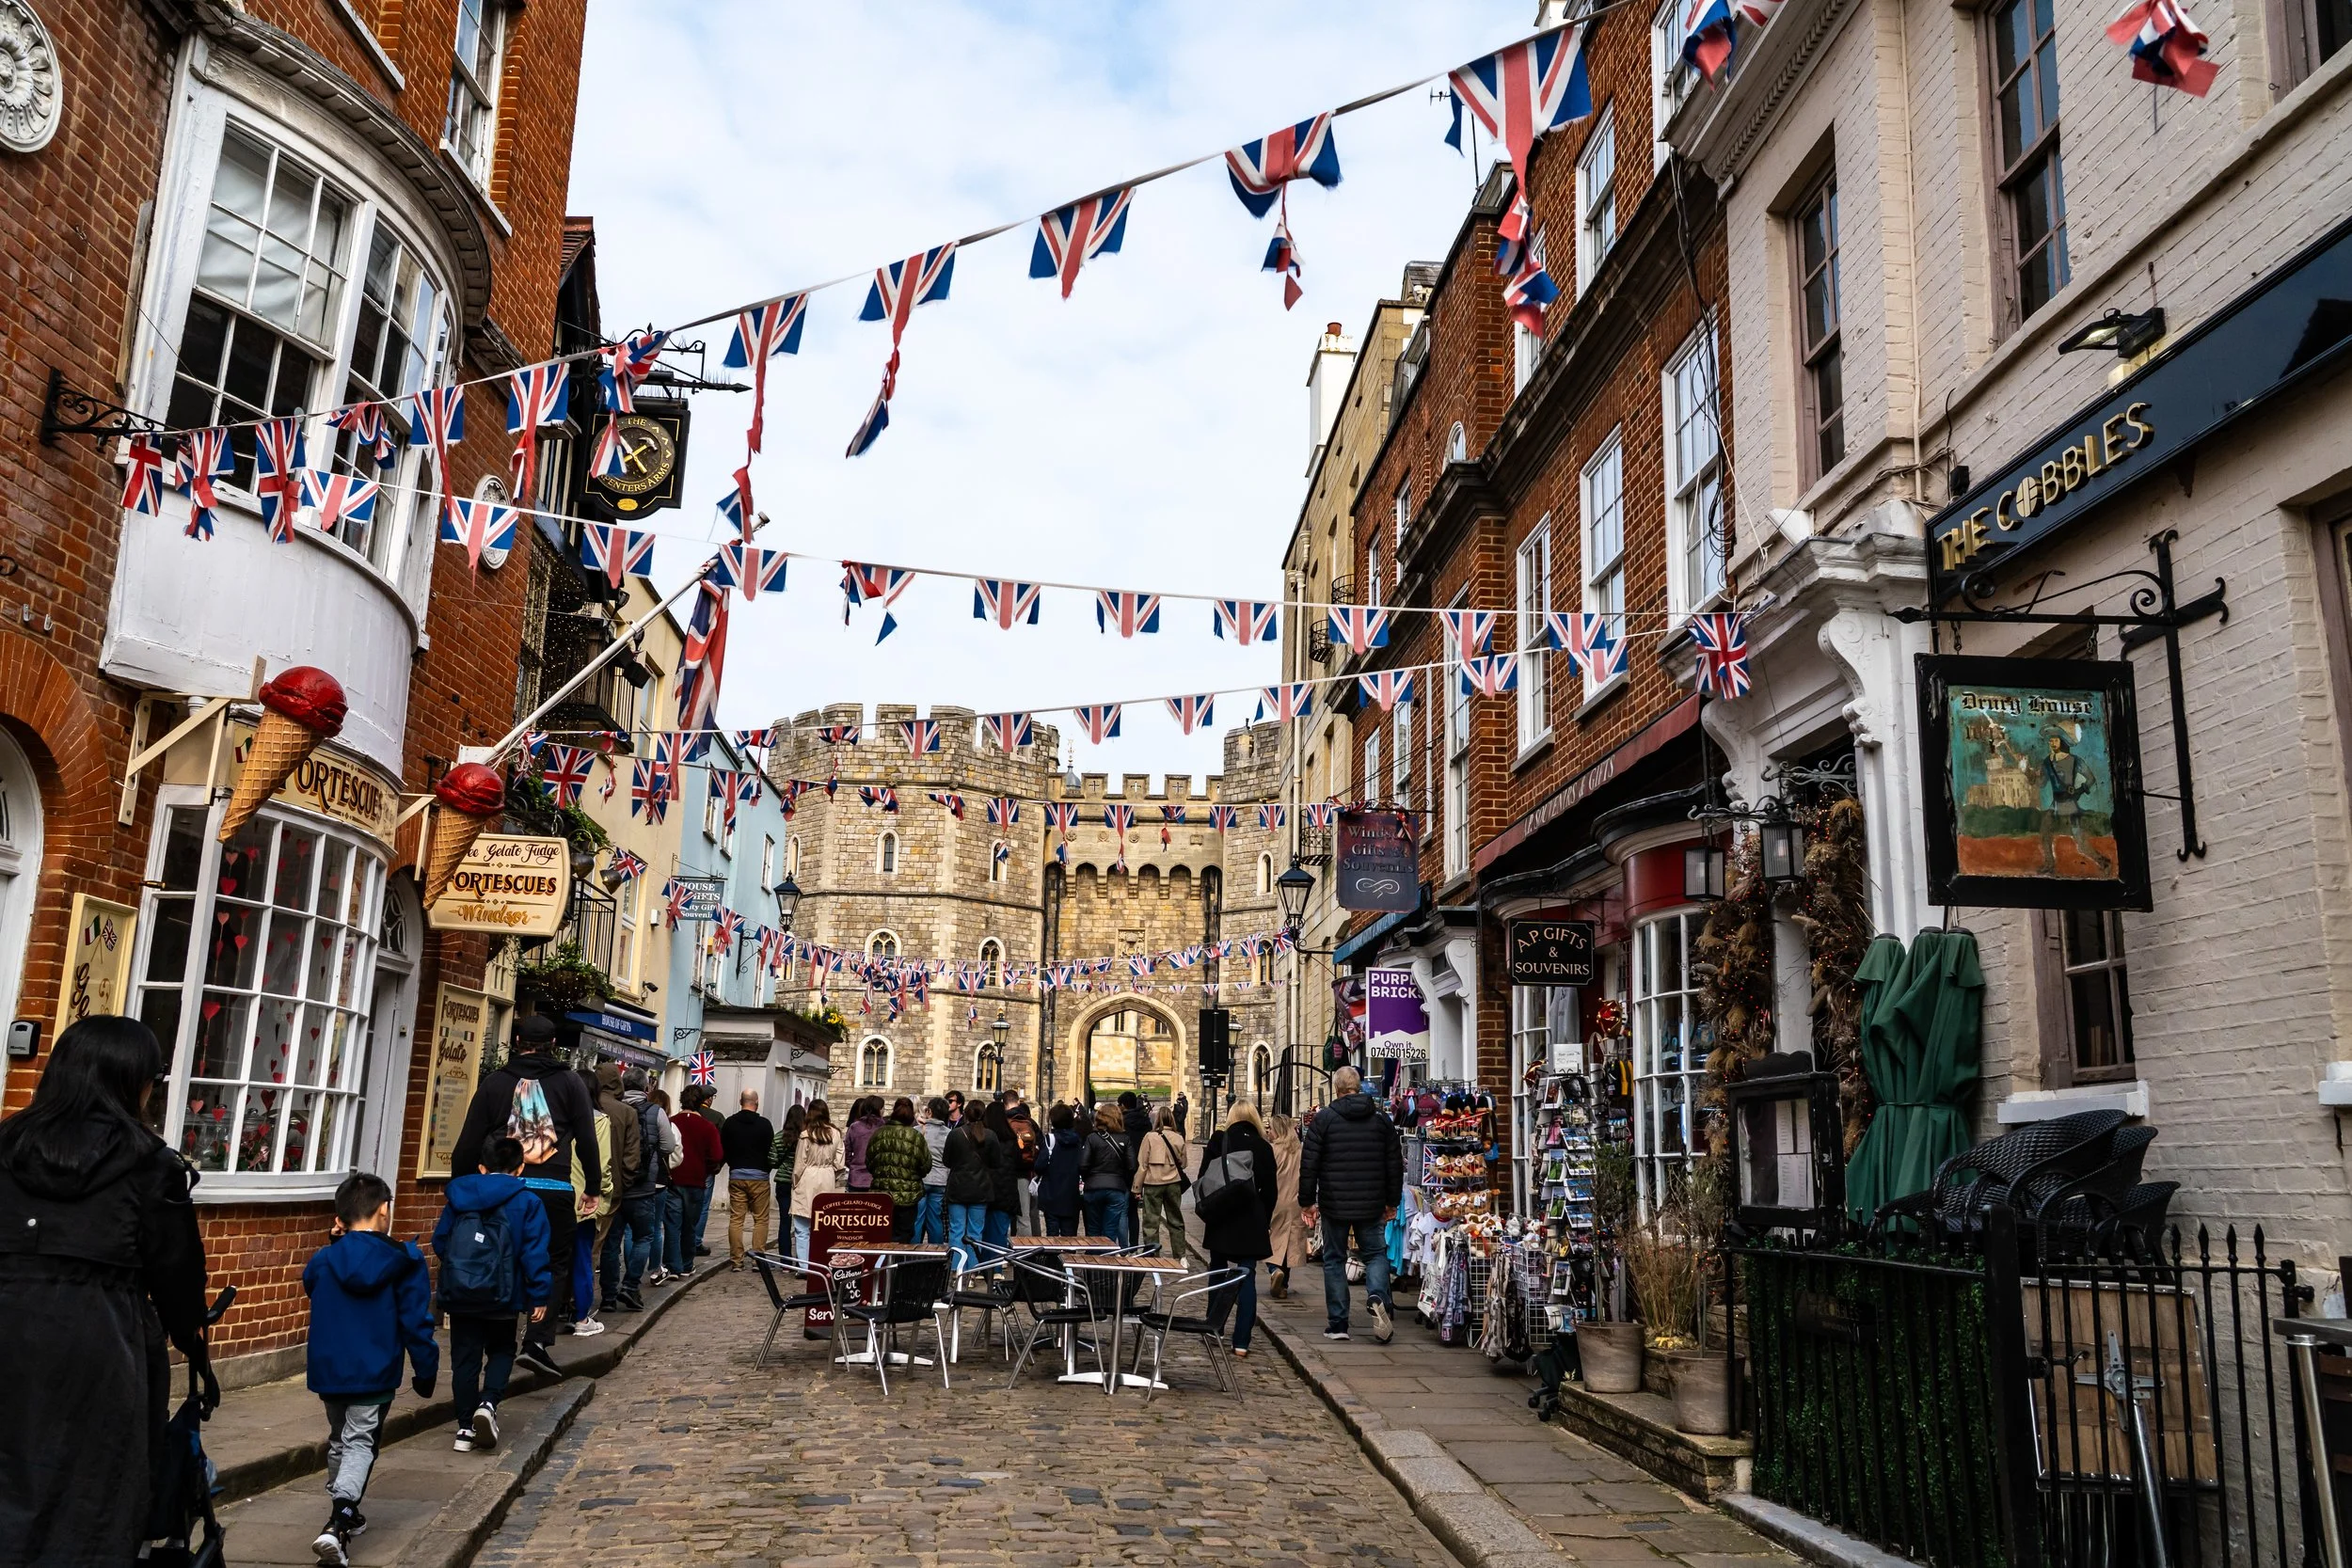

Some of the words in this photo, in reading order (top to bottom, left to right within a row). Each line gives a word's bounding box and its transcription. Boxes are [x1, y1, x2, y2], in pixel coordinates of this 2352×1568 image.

[627, 417, 647, 426] THE
[600, 474, 647, 492] PENTERS
[646, 462, 670, 487] ARMS
[1936, 506, 1995, 571] THE
[2027, 694, 2094, 715] House
[1588, 754, 1615, 791] GIFTS
[484, 844, 521, 862] Gelato
[521, 844, 560, 865] Fudge
[1351, 843, 1385, 857] Gifts
[1343, 857, 1415, 873] Souvenirs
[452, 871, 558, 898] ORTESCUES
[457, 904, 532, 927] Windsor
[1517, 929, 1541, 954] A.P.
[1543, 927, 1588, 950] GIFTS
[1549, 946, 1558, 958] &
[1515, 961, 1590, 975] SOUVENIRS
[1371, 972, 1416, 986] PURPL
[602, 1014, 614, 1028] HOUSE
[620, 1020, 631, 1033] GIFTS
[437, 1037, 468, 1069] Gelato
[1371, 1047, 1426, 1059] 07479015226
[1384, 1040, 1404, 1049] Own
[1406, 1040, 1415, 1049] it.
[813, 1210, 890, 1231] FORTESCUES
